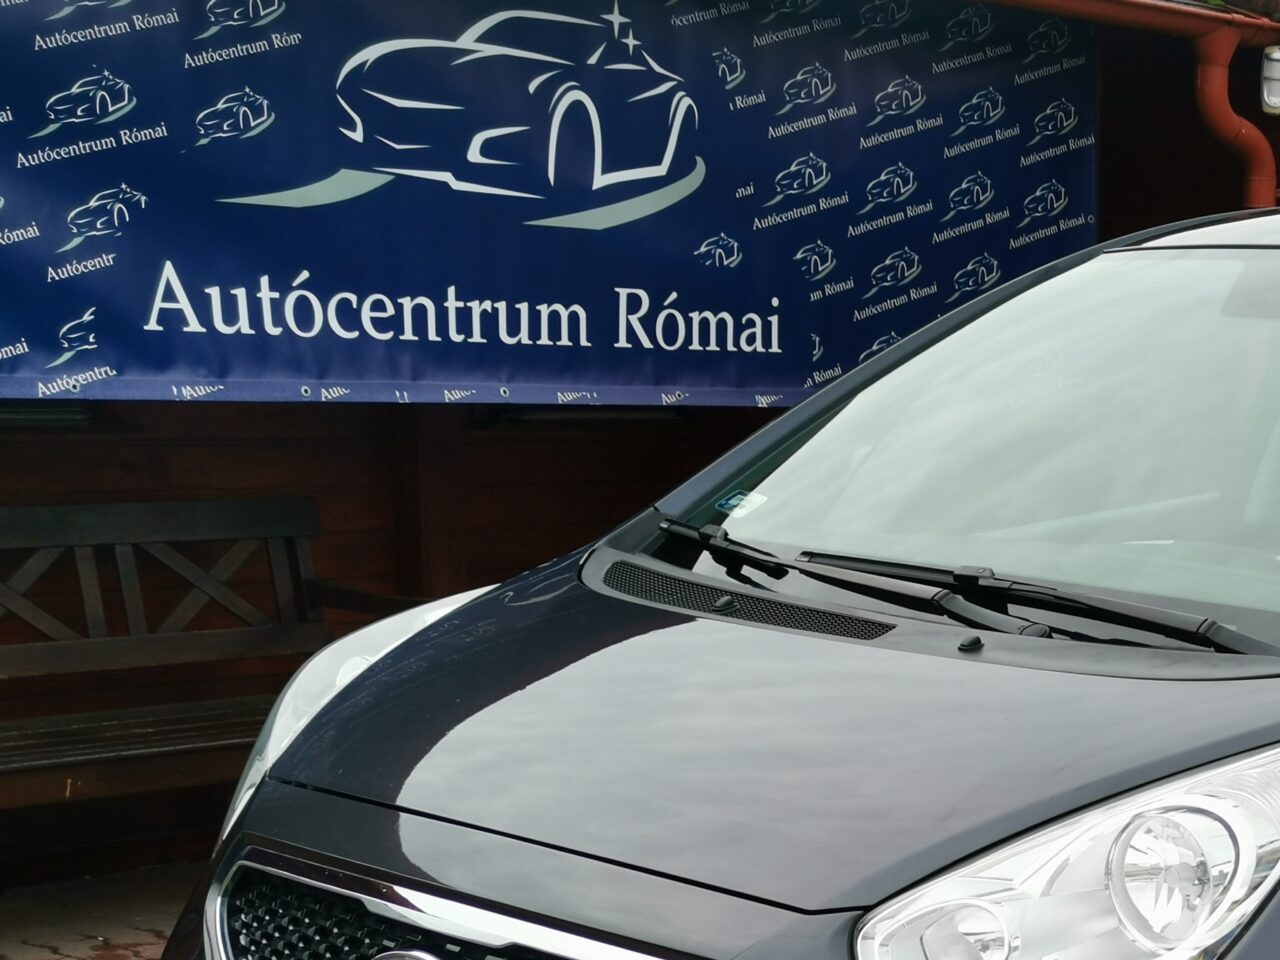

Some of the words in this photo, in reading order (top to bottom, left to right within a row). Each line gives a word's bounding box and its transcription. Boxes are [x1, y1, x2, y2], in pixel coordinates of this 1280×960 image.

[720, 1, 750, 16] Római
[34, 21, 131, 50] Autócentrum
[132, 8, 180, 31] Római
[752, 26, 811, 47] Autócentrum
[811, 14, 841, 31] Római
[843, 39, 900, 62] Autócentrum
[901, 30, 930, 46] Római
[184, 39, 270, 68] Autócentrum
[932, 53, 985, 75] Autócentrum
[985, 43, 1012, 59] Római
[1013, 64, 1062, 86] Autócentrum
[1062, 55, 1086, 70] Római
[735, 89, 766, 109] Római
[768, 114, 827, 139] Autócentrum
[827, 102, 857, 120] Római
[859, 125, 915, 149] Autócentrum
[916, 113, 944, 131] Római
[17, 136, 117, 168] Autócentrum
[119, 122, 168, 146] Római
[943, 135, 994, 159] Autócentrum
[995, 123, 1020, 142] Római
[1019, 144, 1068, 168] Autócentrum
[1068, 133, 1095, 151] Római
[752, 204, 817, 230] Autócentrum
[818, 191, 849, 211] Római
[847, 212, 905, 238] Autócentrum
[906, 198, 933, 218] Római
[931, 217, 985, 244] Autócentrum
[985, 206, 1010, 225] Római
[1009, 225, 1059, 250] Autócentrum
[1059, 213, 1085, 232] Római
[824, 276, 855, 297] Római
[853, 295, 909, 322] Autócentrum
[909, 281, 938, 301] Római
[143, 260, 592, 347] Autócentrum
[613, 287, 783, 354] Római
[813, 366, 842, 385] Római
